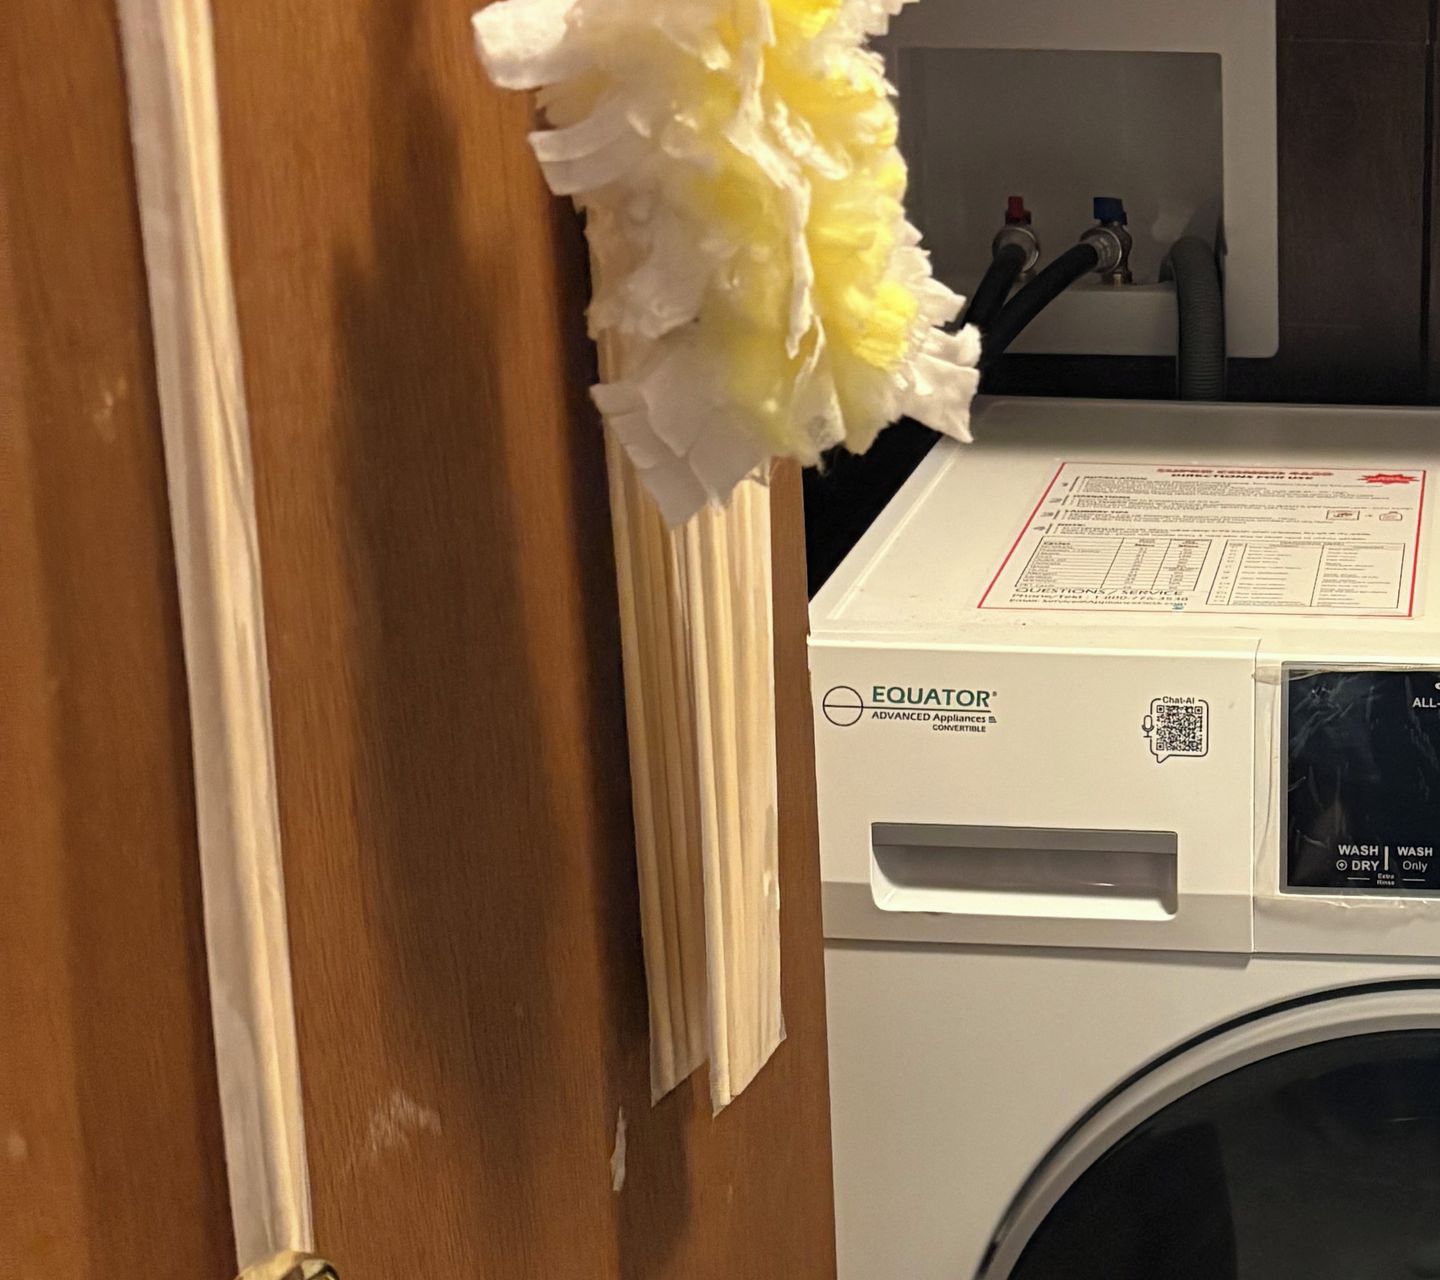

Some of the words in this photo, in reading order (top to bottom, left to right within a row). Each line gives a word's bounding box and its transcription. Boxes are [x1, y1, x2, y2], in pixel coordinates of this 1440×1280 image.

[872, 685, 991, 707] EQUATOR
[1162, 696, 1195, 704] Chat-AI
[871, 711, 931, 721] ADVANCED
[932, 713, 986, 723] Appliances
[932, 724, 987, 732] CONVERTIBLE
[1338, 845, 1379, 856] WASH
[1397, 846, 1433, 857] WASH
[1351, 860, 1380, 871] DRY
[1402, 860, 1428, 873] Only
